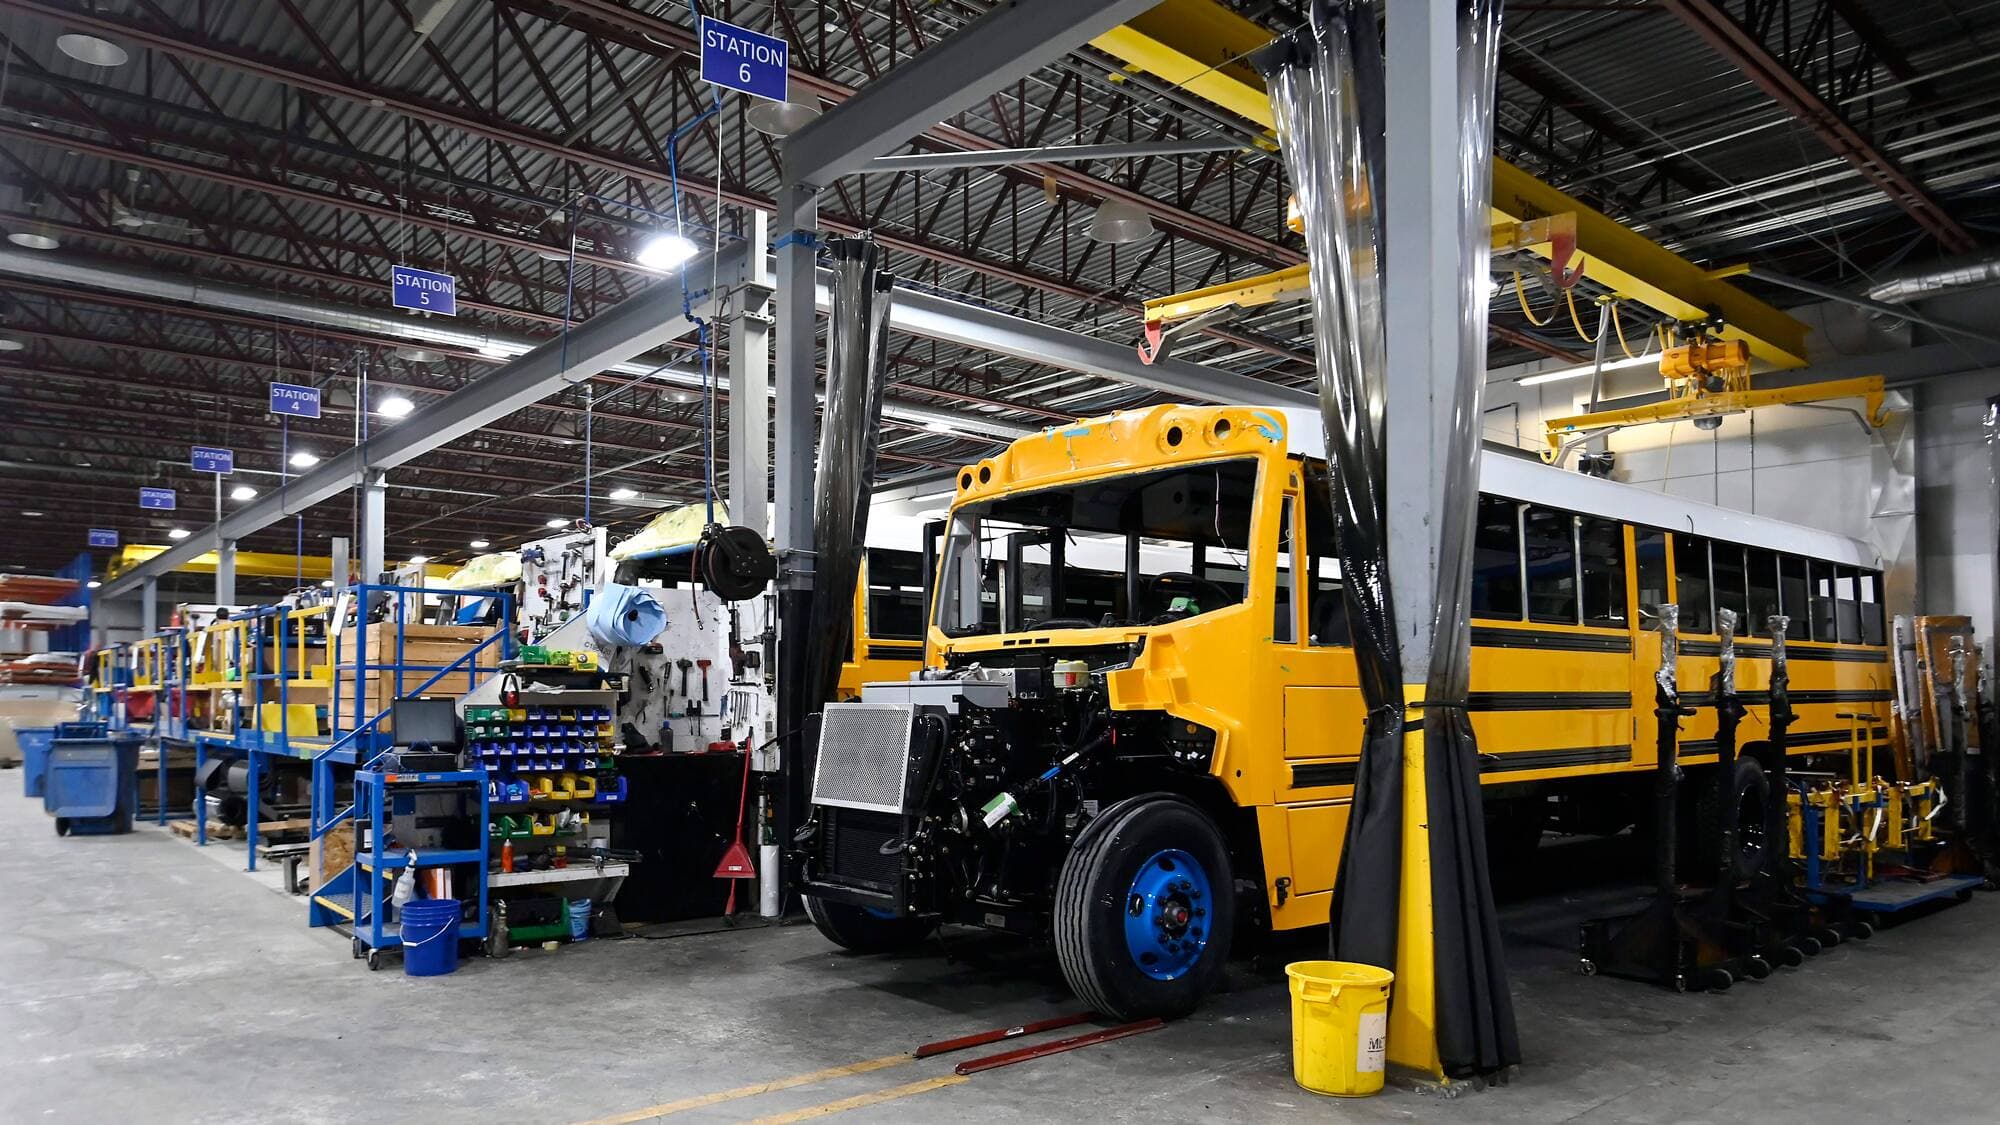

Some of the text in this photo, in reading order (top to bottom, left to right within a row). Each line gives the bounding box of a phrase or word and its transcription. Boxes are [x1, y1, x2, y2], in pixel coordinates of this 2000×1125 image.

[706, 29, 783, 68] STATION
[739, 63, 751, 83] 6
[396, 274, 451, 293] STATION
[421, 292, 430, 305] 5
[273, 388, 317, 402] STATION
[291, 401, 300, 411] 4
[194, 451, 231, 461] STATION
[209, 460, 216, 469] 3
